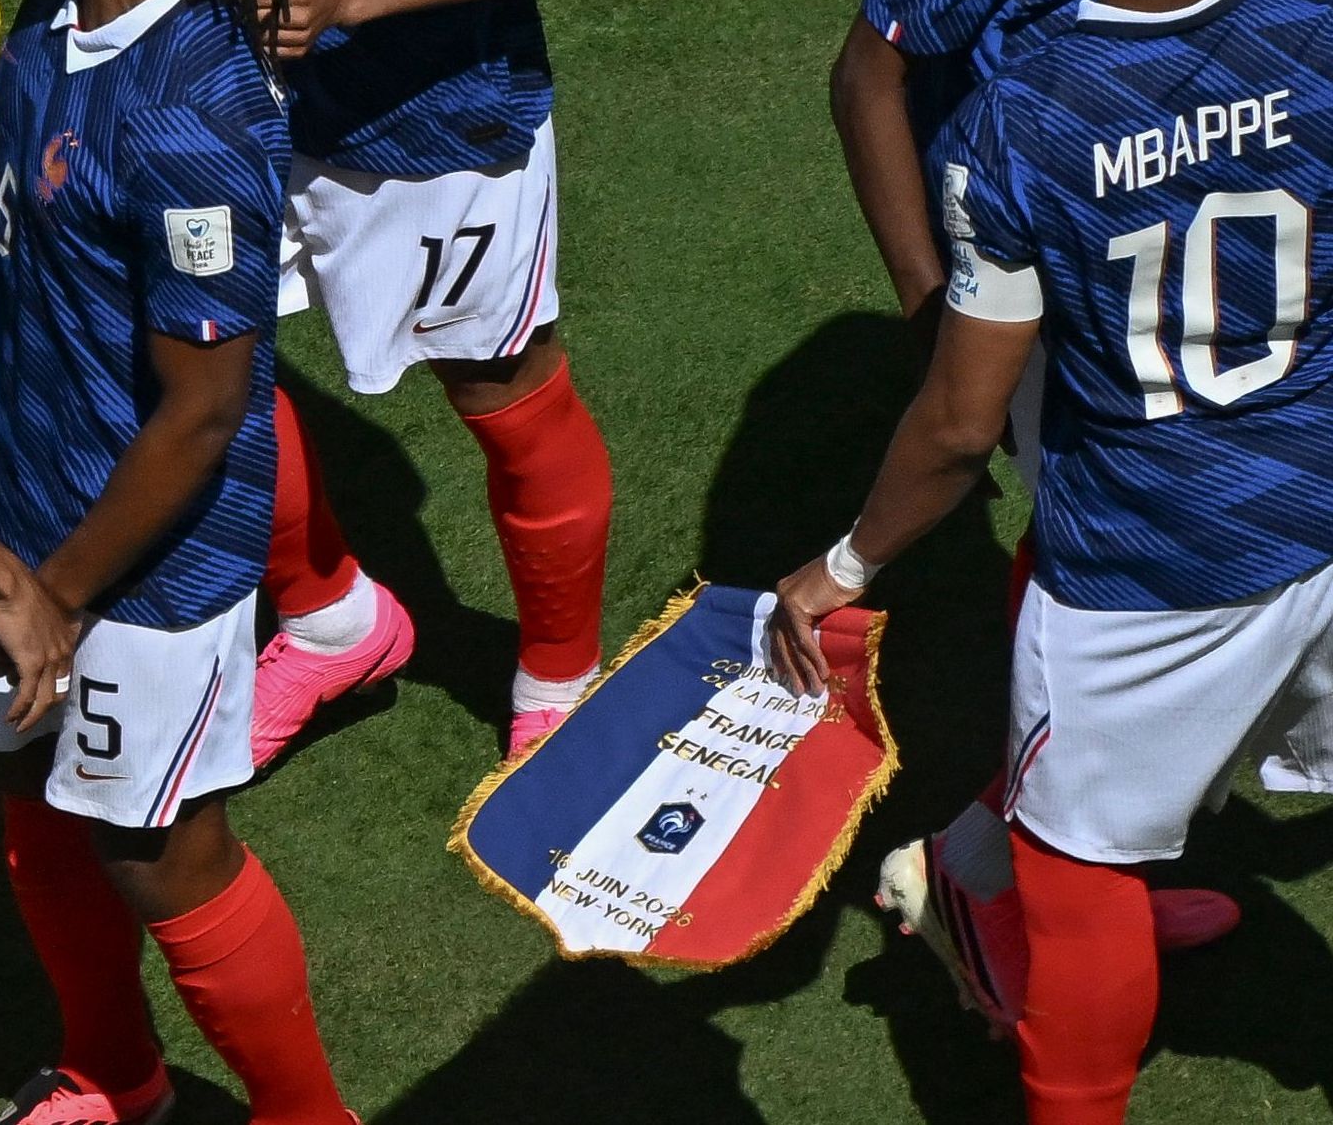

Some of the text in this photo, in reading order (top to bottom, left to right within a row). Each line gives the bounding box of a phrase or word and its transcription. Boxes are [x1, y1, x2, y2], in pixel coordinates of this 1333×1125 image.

[1093, 89, 1293, 199] MBAPPE
[187, 249, 215, 261] PEACE
[412, 223, 496, 311] 17
[1107, 189, 1313, 421] 10
[76, 676, 122, 761] 5
[699, 706, 806, 752] FRANCE
[762, 695, 801, 715] FIFA
[657, 731, 782, 789] SENEGAL
[550, 879, 663, 942] NEW-YORK
[575, 868, 630, 899] JUIN
[630, 891, 694, 928] 2026
